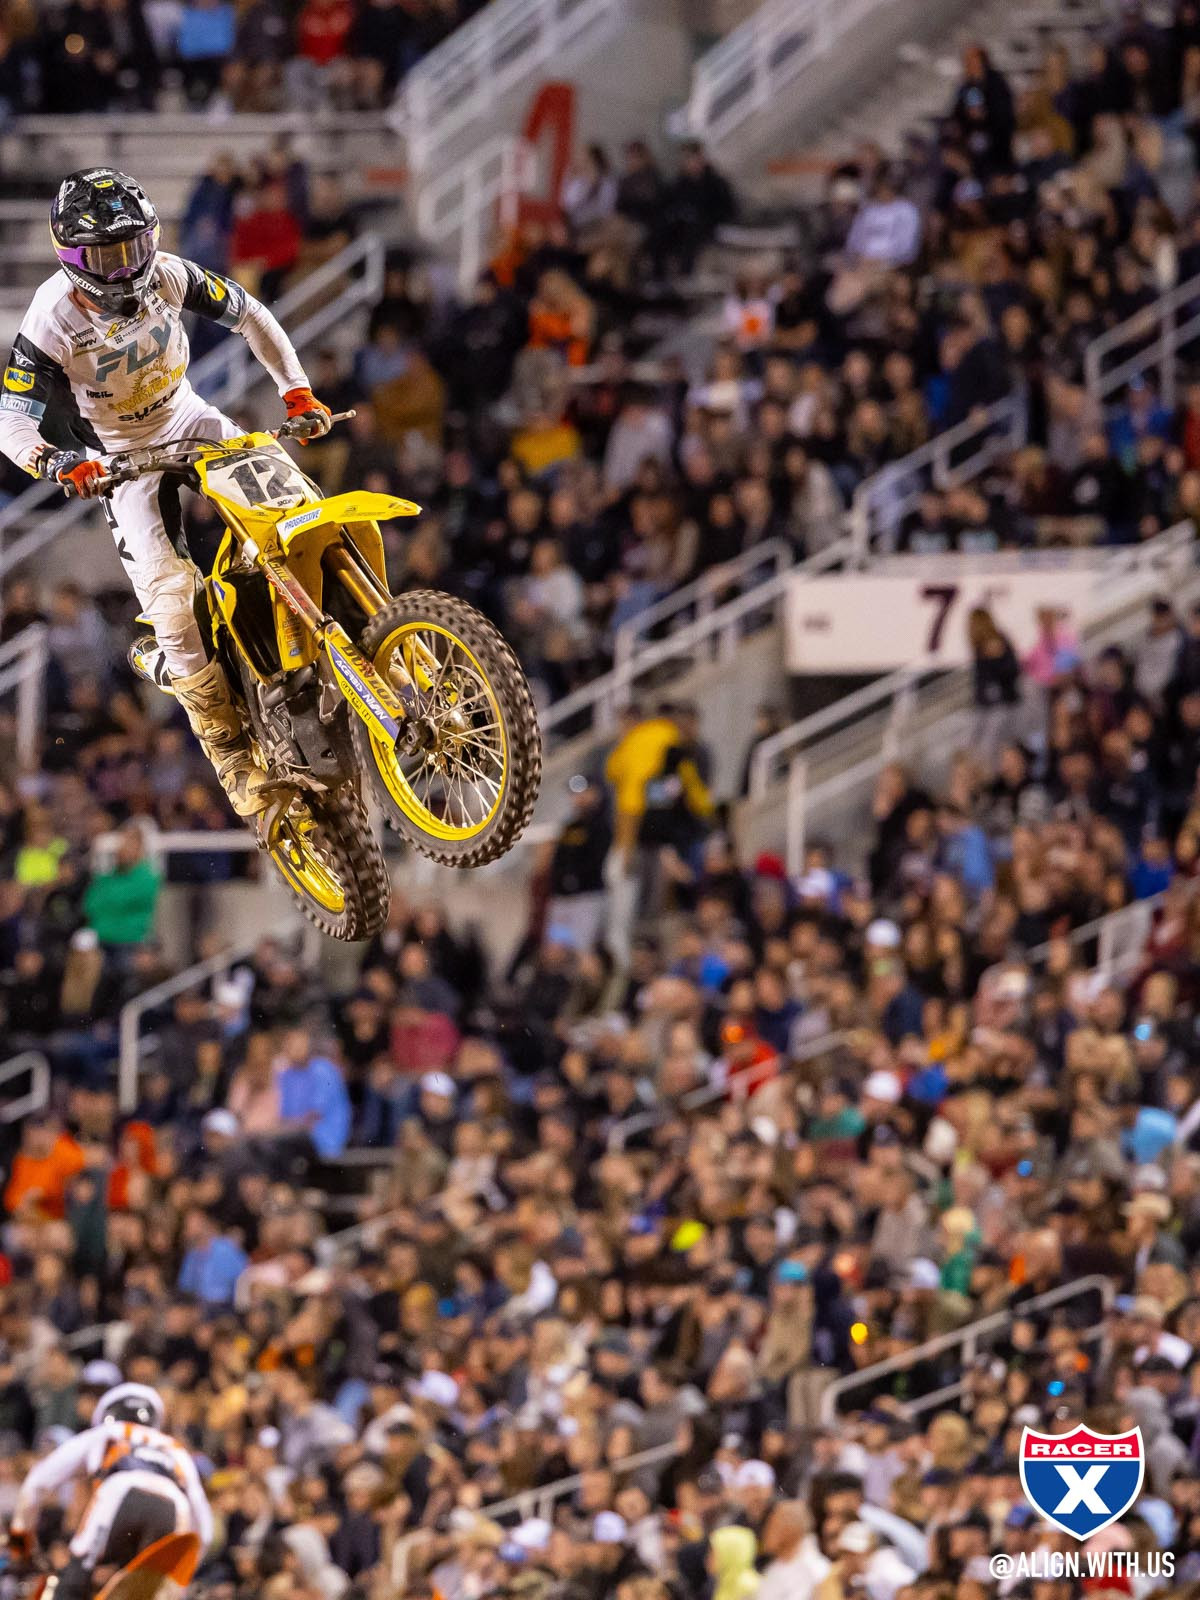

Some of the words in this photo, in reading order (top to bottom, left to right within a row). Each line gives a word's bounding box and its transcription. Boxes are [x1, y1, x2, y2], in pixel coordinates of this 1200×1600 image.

[106, 219, 132, 232] TWISTED
[96, 319, 171, 382] FLY
[227, 458, 302, 507] 12
[284, 509, 321, 532] PROGRESSIVE
[922, 583, 957, 651] 7
[335, 659, 363, 692] ACERBIS
[341, 646, 401, 711] DUNLOP
